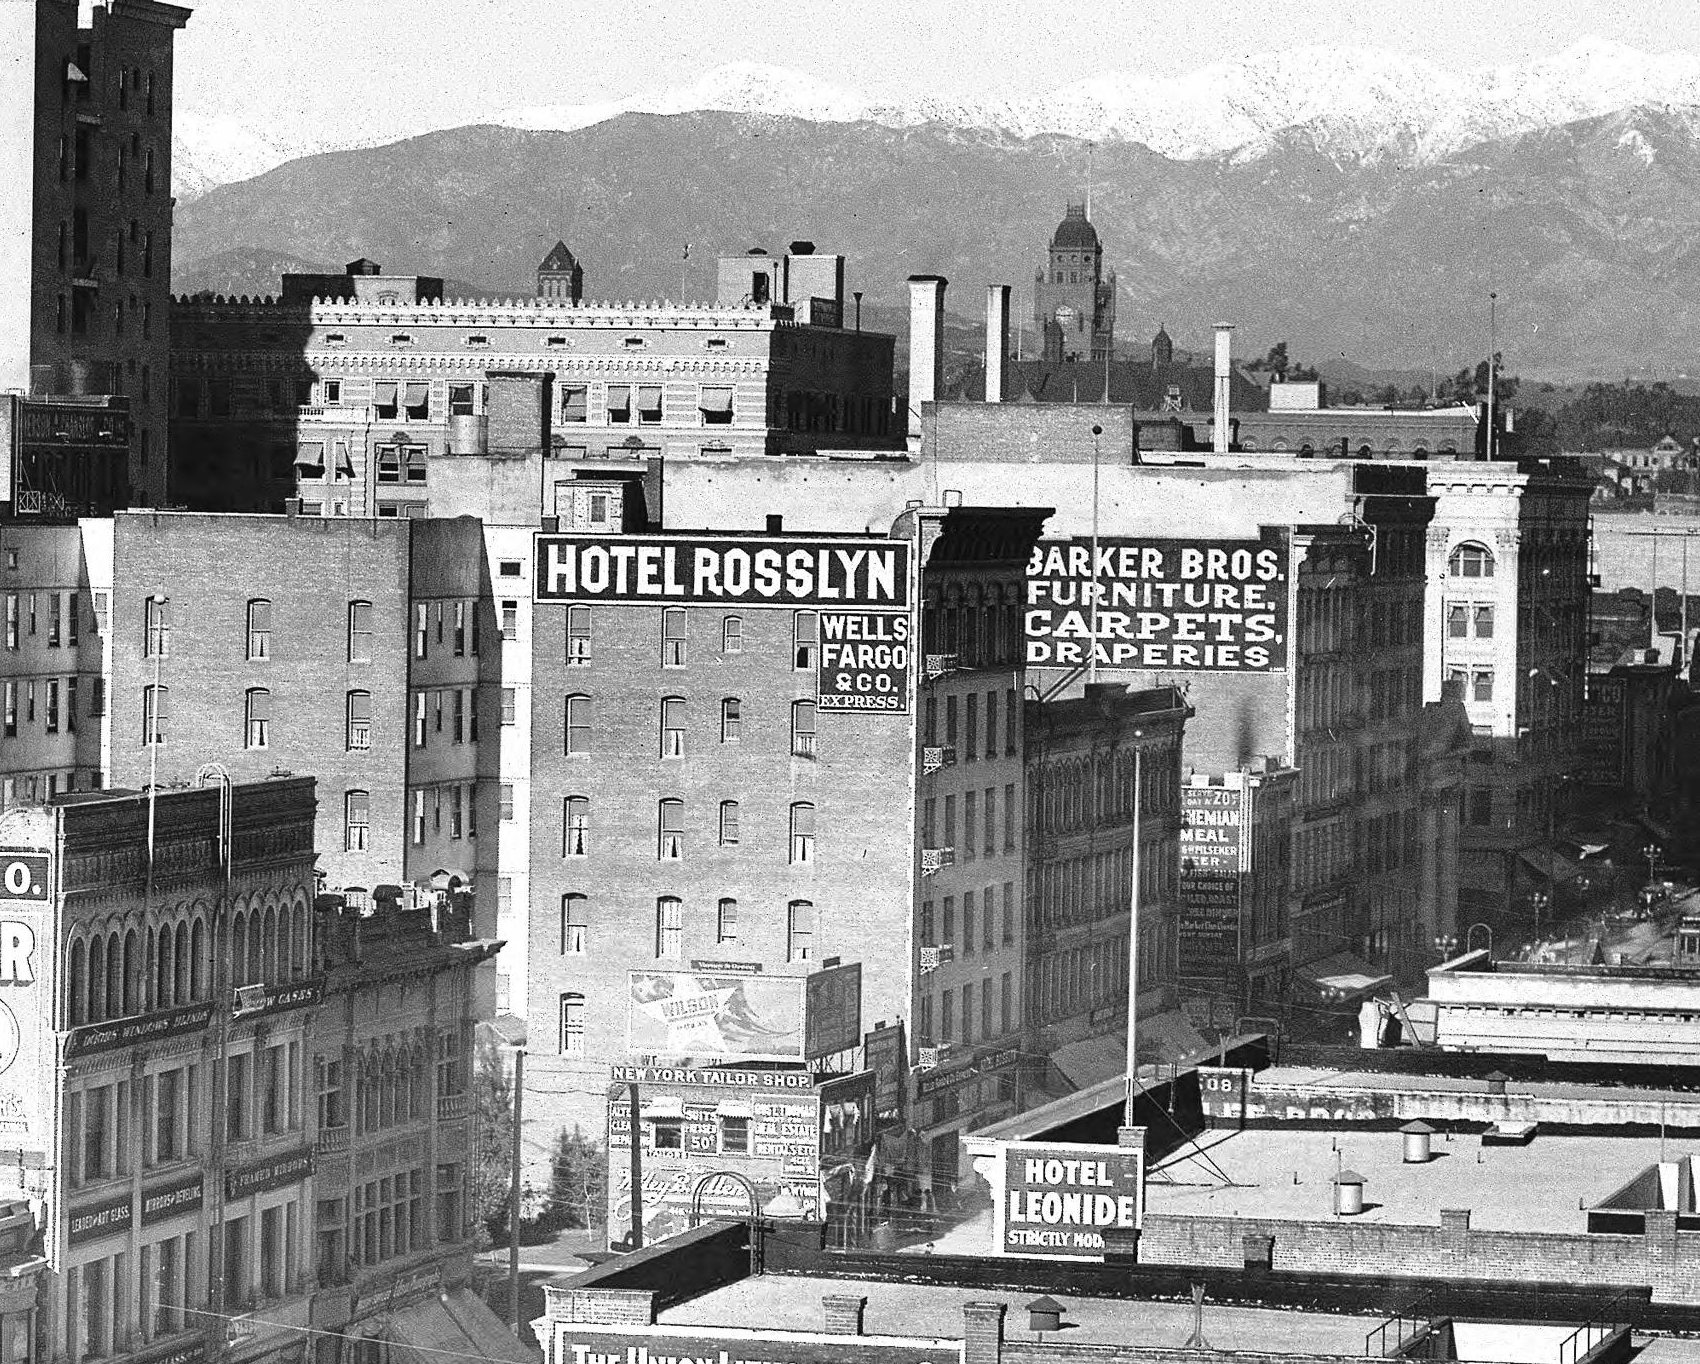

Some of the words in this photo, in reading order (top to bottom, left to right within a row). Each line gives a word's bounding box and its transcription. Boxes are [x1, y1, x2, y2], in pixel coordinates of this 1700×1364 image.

[547, 545, 683, 599] HOTEL
[693, 547, 895, 600] ROSSLYN
[1026, 546, 1164, 579] BARKER
[1183, 550, 1285, 581] BROS.
[1026, 584, 1276, 612] FURNITURE,
[822, 615, 908, 641] WELLS
[1026, 610, 1284, 645] CARPETS,
[822, 644, 907, 670] FARGO
[1026, 643, 1269, 667] DRAPERIES
[819, 695, 906, 710] EXPRESS.
[1180, 829, 1229, 842] MEAL
[278, 988, 312, 1004] CASES
[661, 994, 719, 1017] WILSON
[613, 1067, 647, 1080] NEW
[652, 1069, 697, 1082] YORK
[701, 1071, 758, 1086] TAILOR
[763, 1074, 811, 1088] SHOP.
[782, 1124, 817, 1135] ESTATE
[1025, 1158, 1114, 1187] HOTEL
[1009, 1190, 1133, 1227] LEONIDE
[1007, 1229, 1070, 1247] STRICTLY
